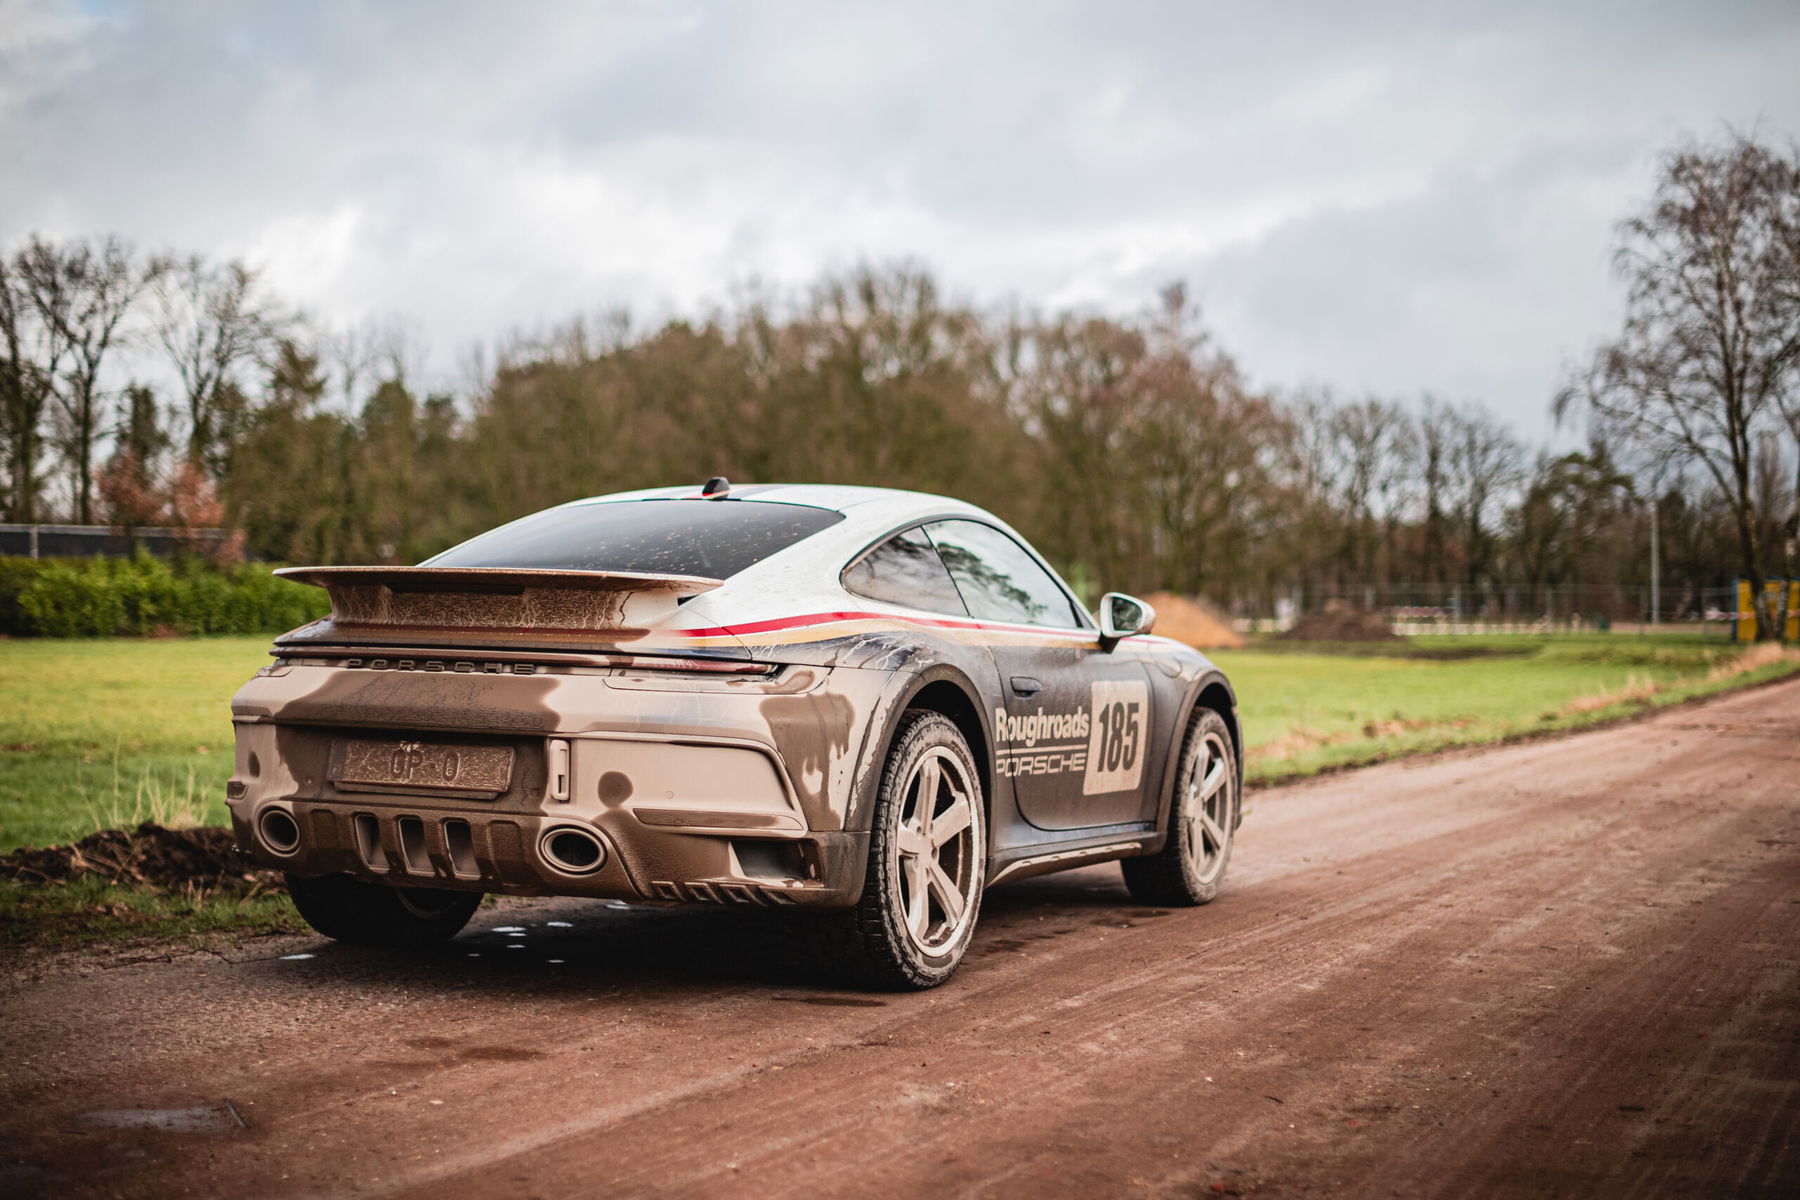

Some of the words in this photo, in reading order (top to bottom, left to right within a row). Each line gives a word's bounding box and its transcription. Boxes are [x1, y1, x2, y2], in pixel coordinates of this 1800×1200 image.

[345, 657, 537, 675] PORSCHE
[995, 706, 1090, 747] Roughroads
[1097, 702, 1140, 773] 185
[996, 752, 1087, 778] PORSCHE
